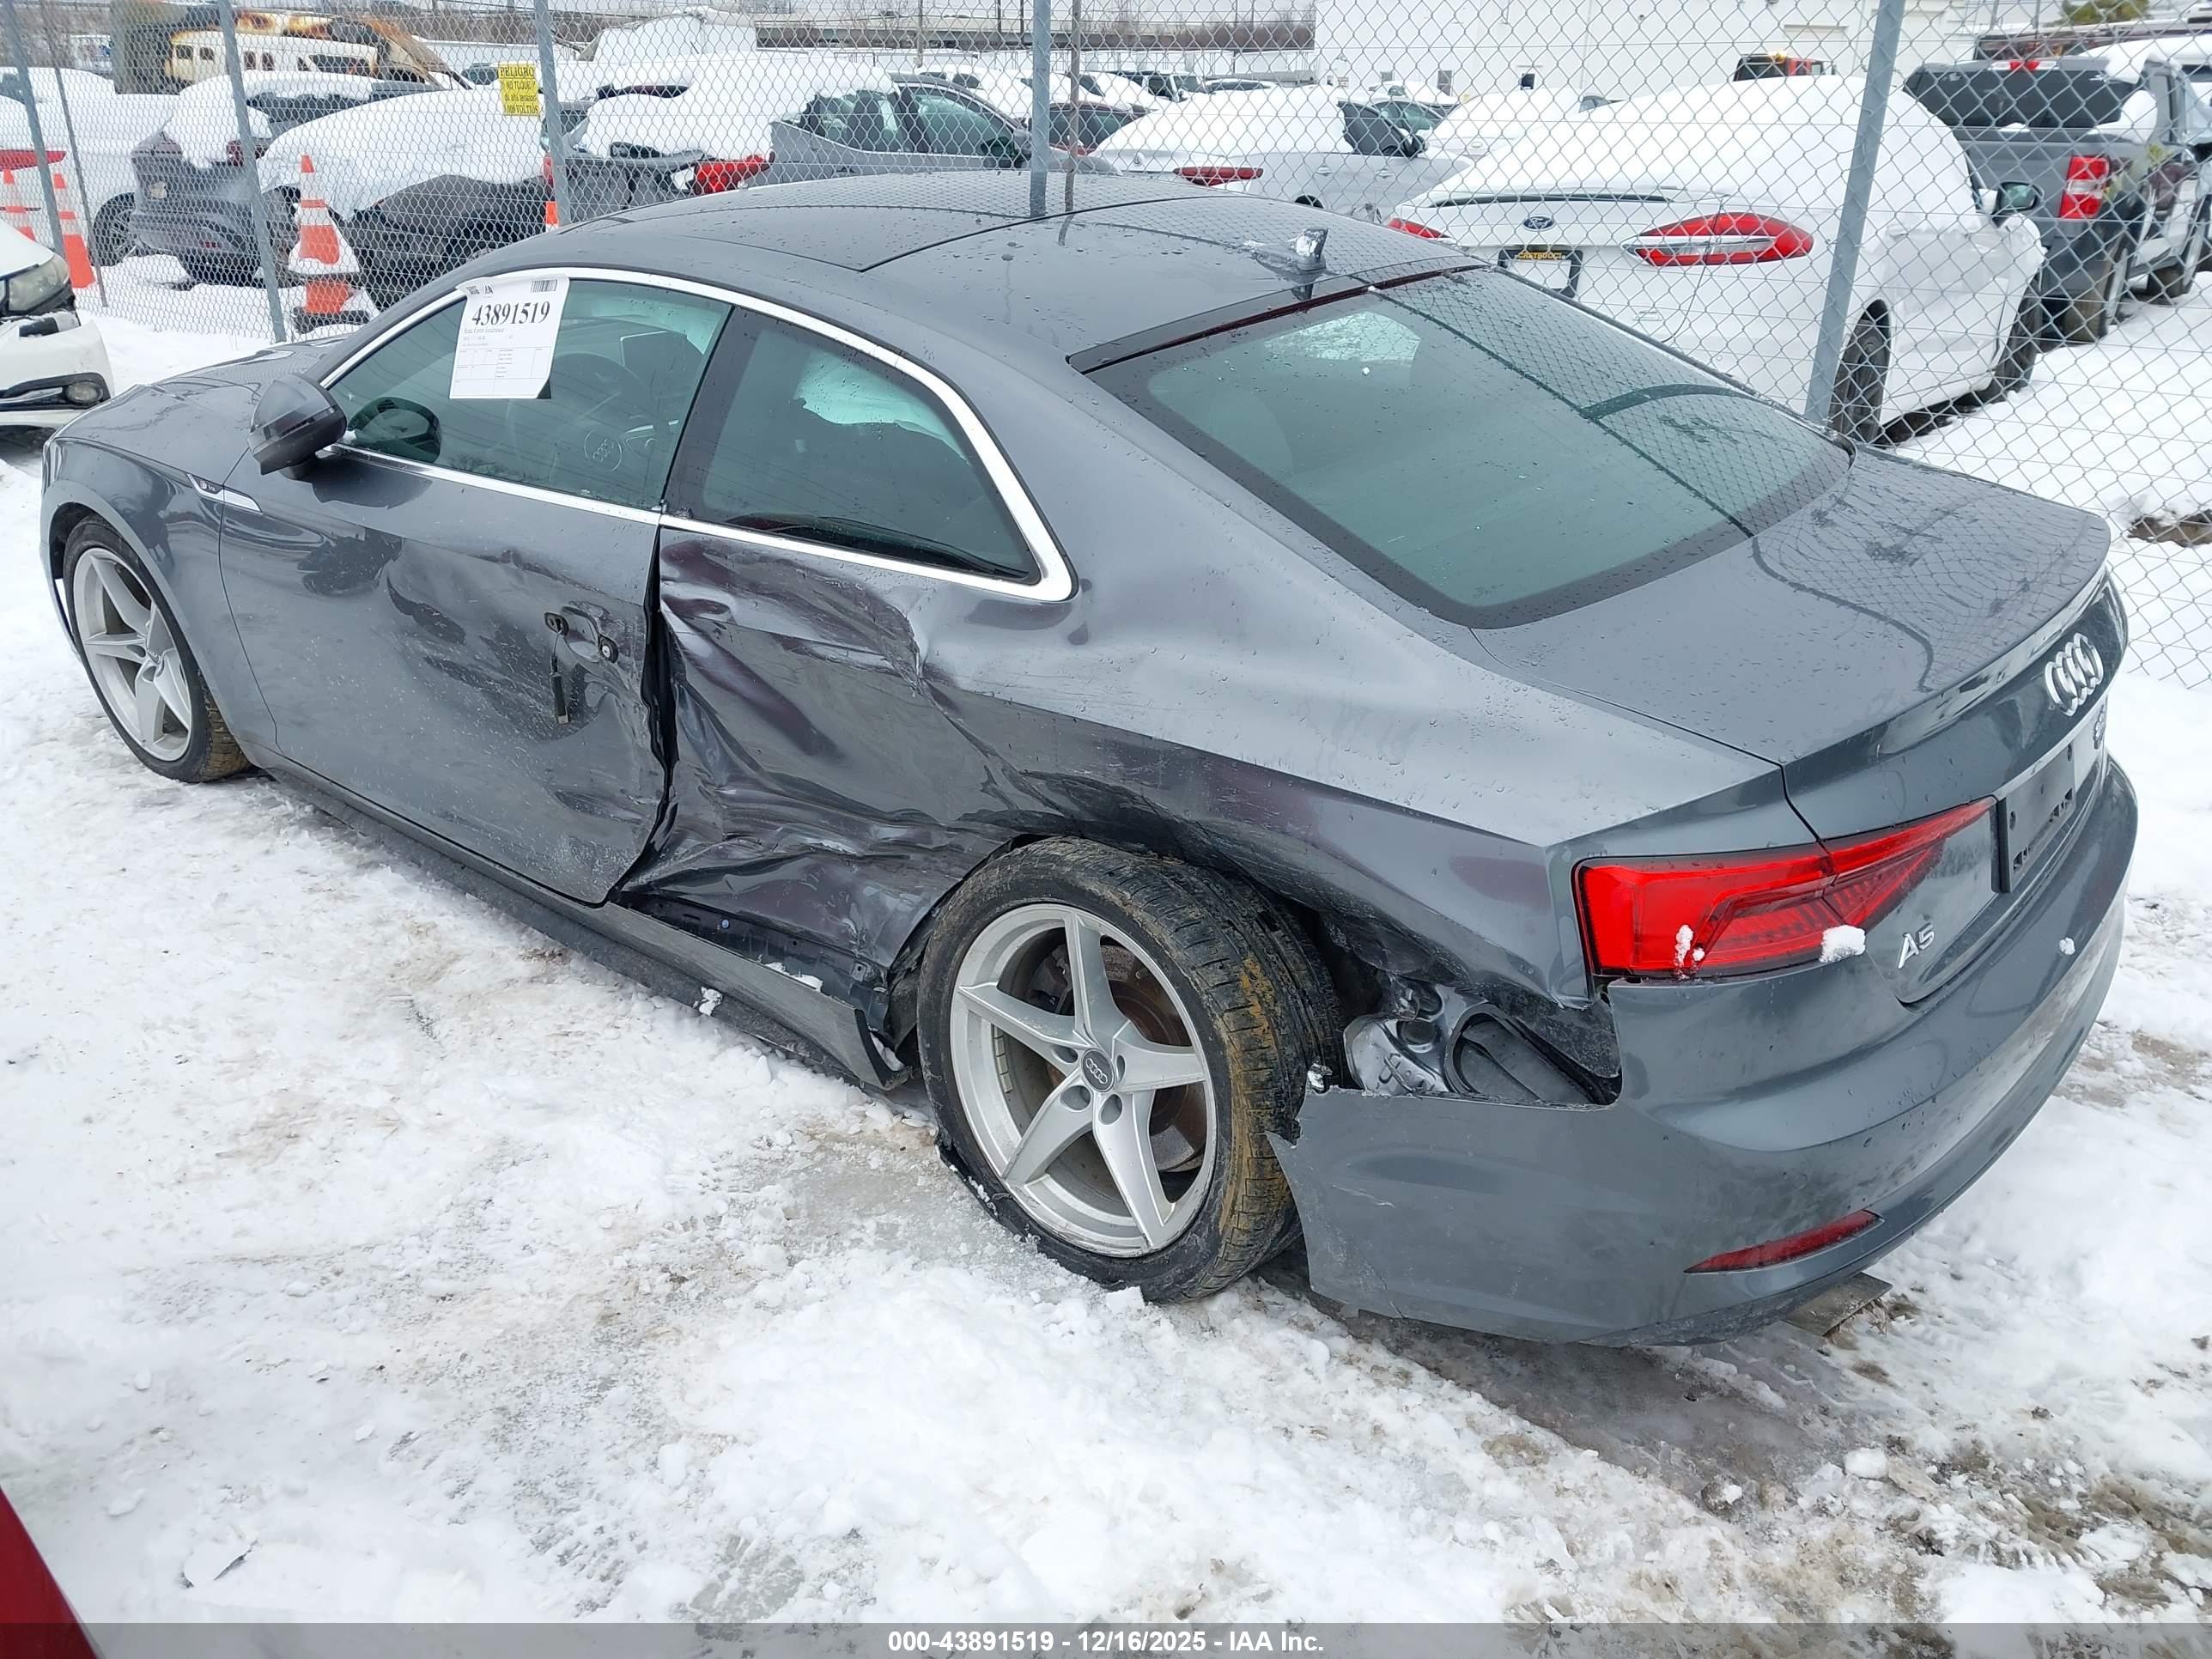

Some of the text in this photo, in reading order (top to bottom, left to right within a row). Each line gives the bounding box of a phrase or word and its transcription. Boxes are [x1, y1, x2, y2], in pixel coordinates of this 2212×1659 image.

[500, 66, 535, 77] PELIGRO
[1527, 216, 1550, 228] Ford
[471, 301, 550, 326] 43891519
[1897, 921, 1936, 969] A5
